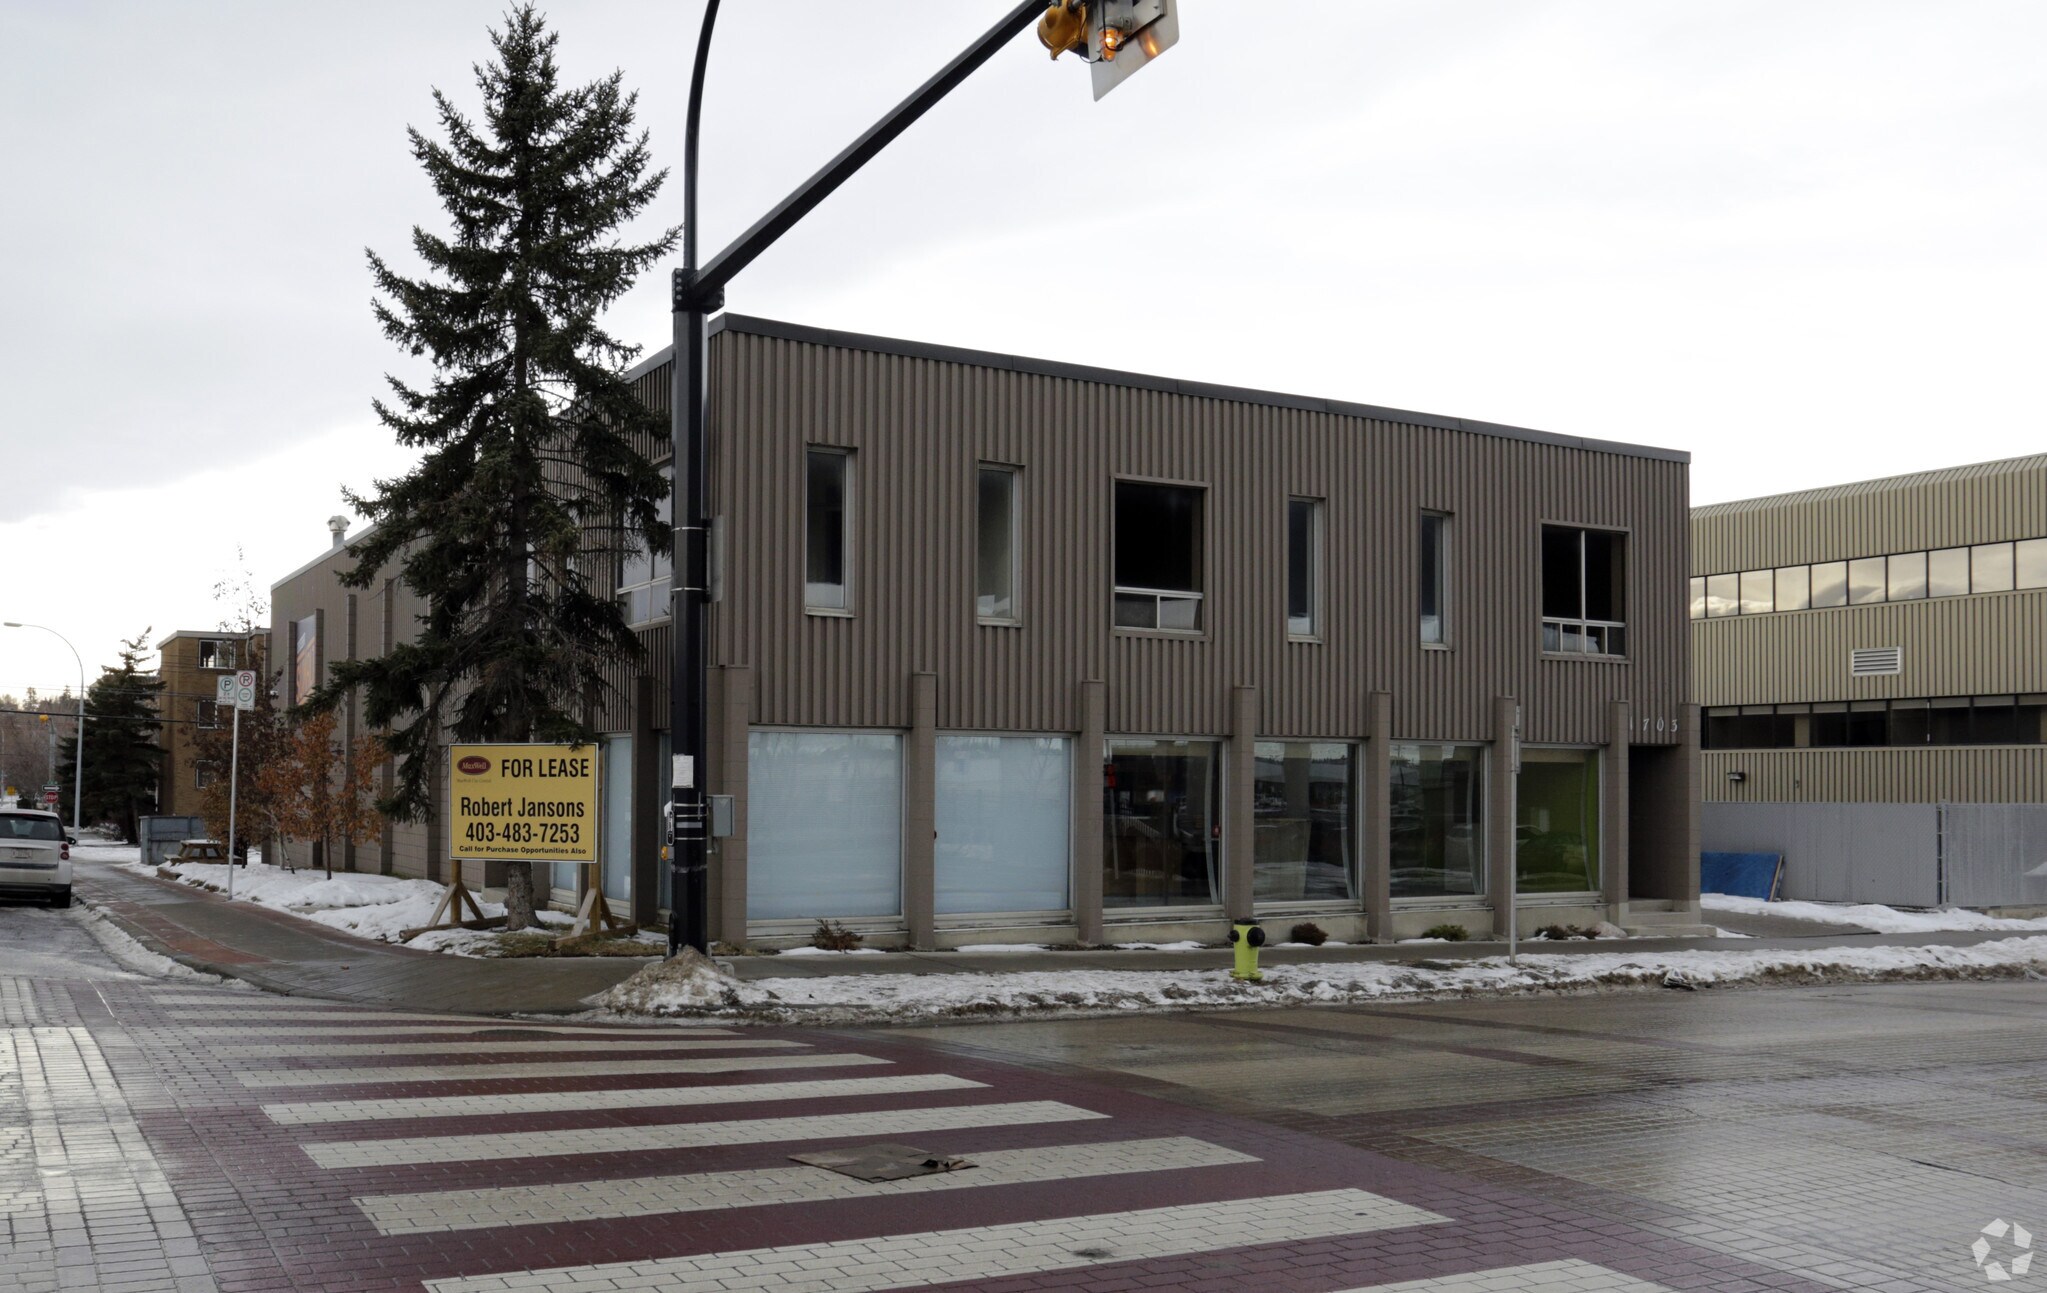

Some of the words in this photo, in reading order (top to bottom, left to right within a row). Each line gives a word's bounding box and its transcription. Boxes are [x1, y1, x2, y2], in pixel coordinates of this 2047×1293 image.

[224, 680, 231, 689] P
[1629, 716, 1678, 732] 1703
[501, 758, 533, 778] FOR
[539, 758, 589, 777] LEASE
[461, 797, 512, 817] Robert
[518, 797, 584, 818] Jansons
[466, 822, 580, 843] 403-483-7253
[521, 846, 569, 854] Opportunities
